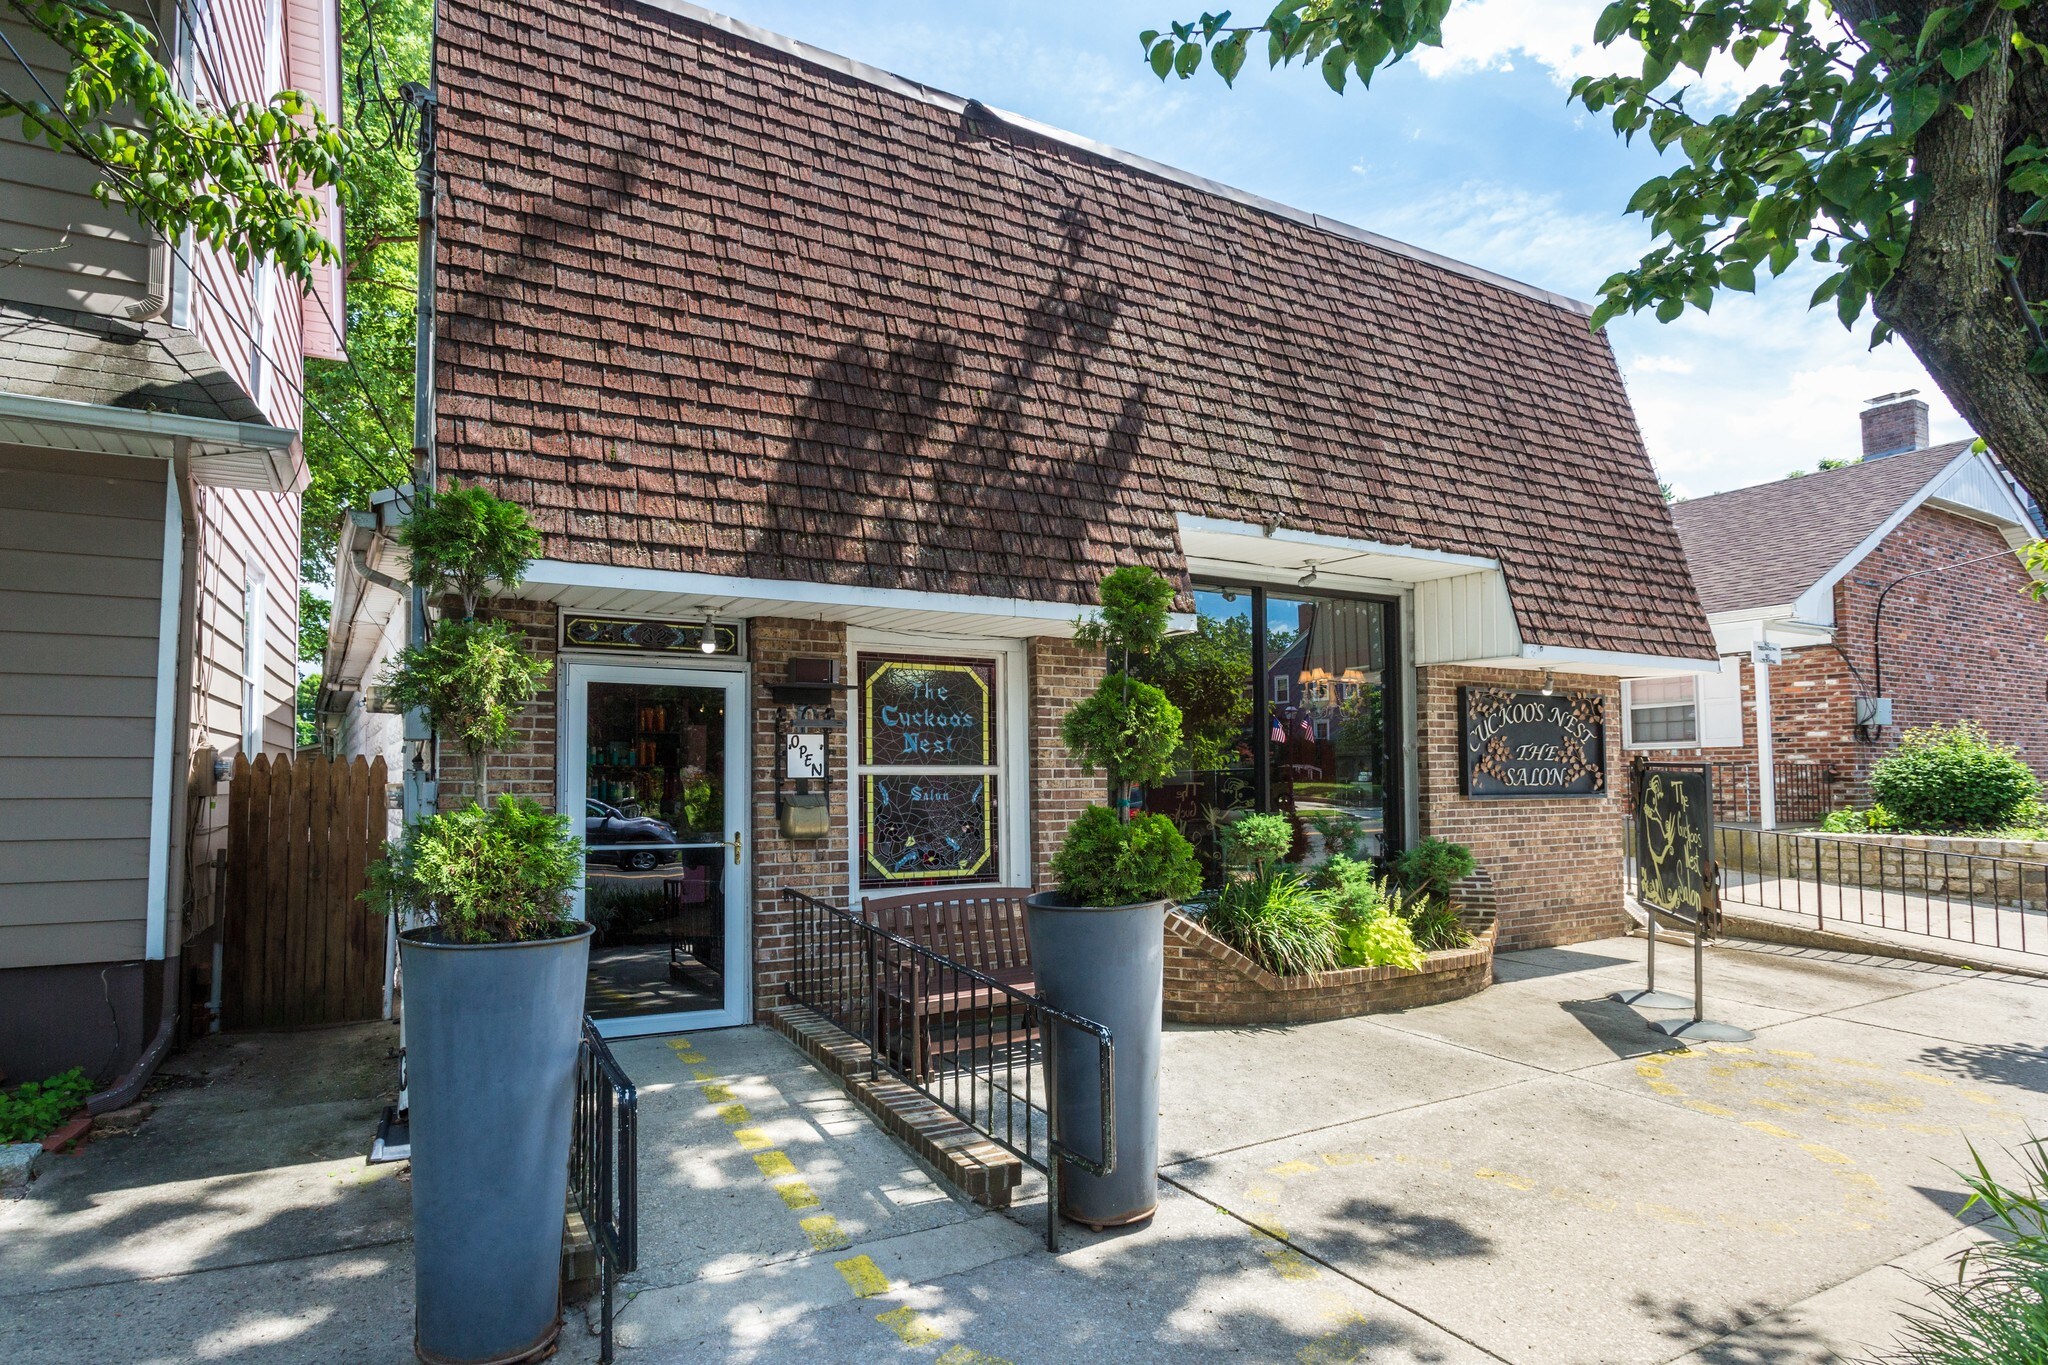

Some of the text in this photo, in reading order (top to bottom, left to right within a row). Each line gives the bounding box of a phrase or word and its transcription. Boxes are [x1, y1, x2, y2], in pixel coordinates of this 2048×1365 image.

[912, 682, 949, 701] The
[881, 705, 974, 728] Cuckoo's
[1469, 702, 1598, 752] CUCKOO'S NEST
[903, 732, 953, 754] Nest
[1516, 742, 1560, 761] THE
[790, 735, 823, 777] OPEN
[1505, 767, 1567, 786] SALON
[910, 786, 950, 801] Salon
[1671, 781, 1689, 812] The
